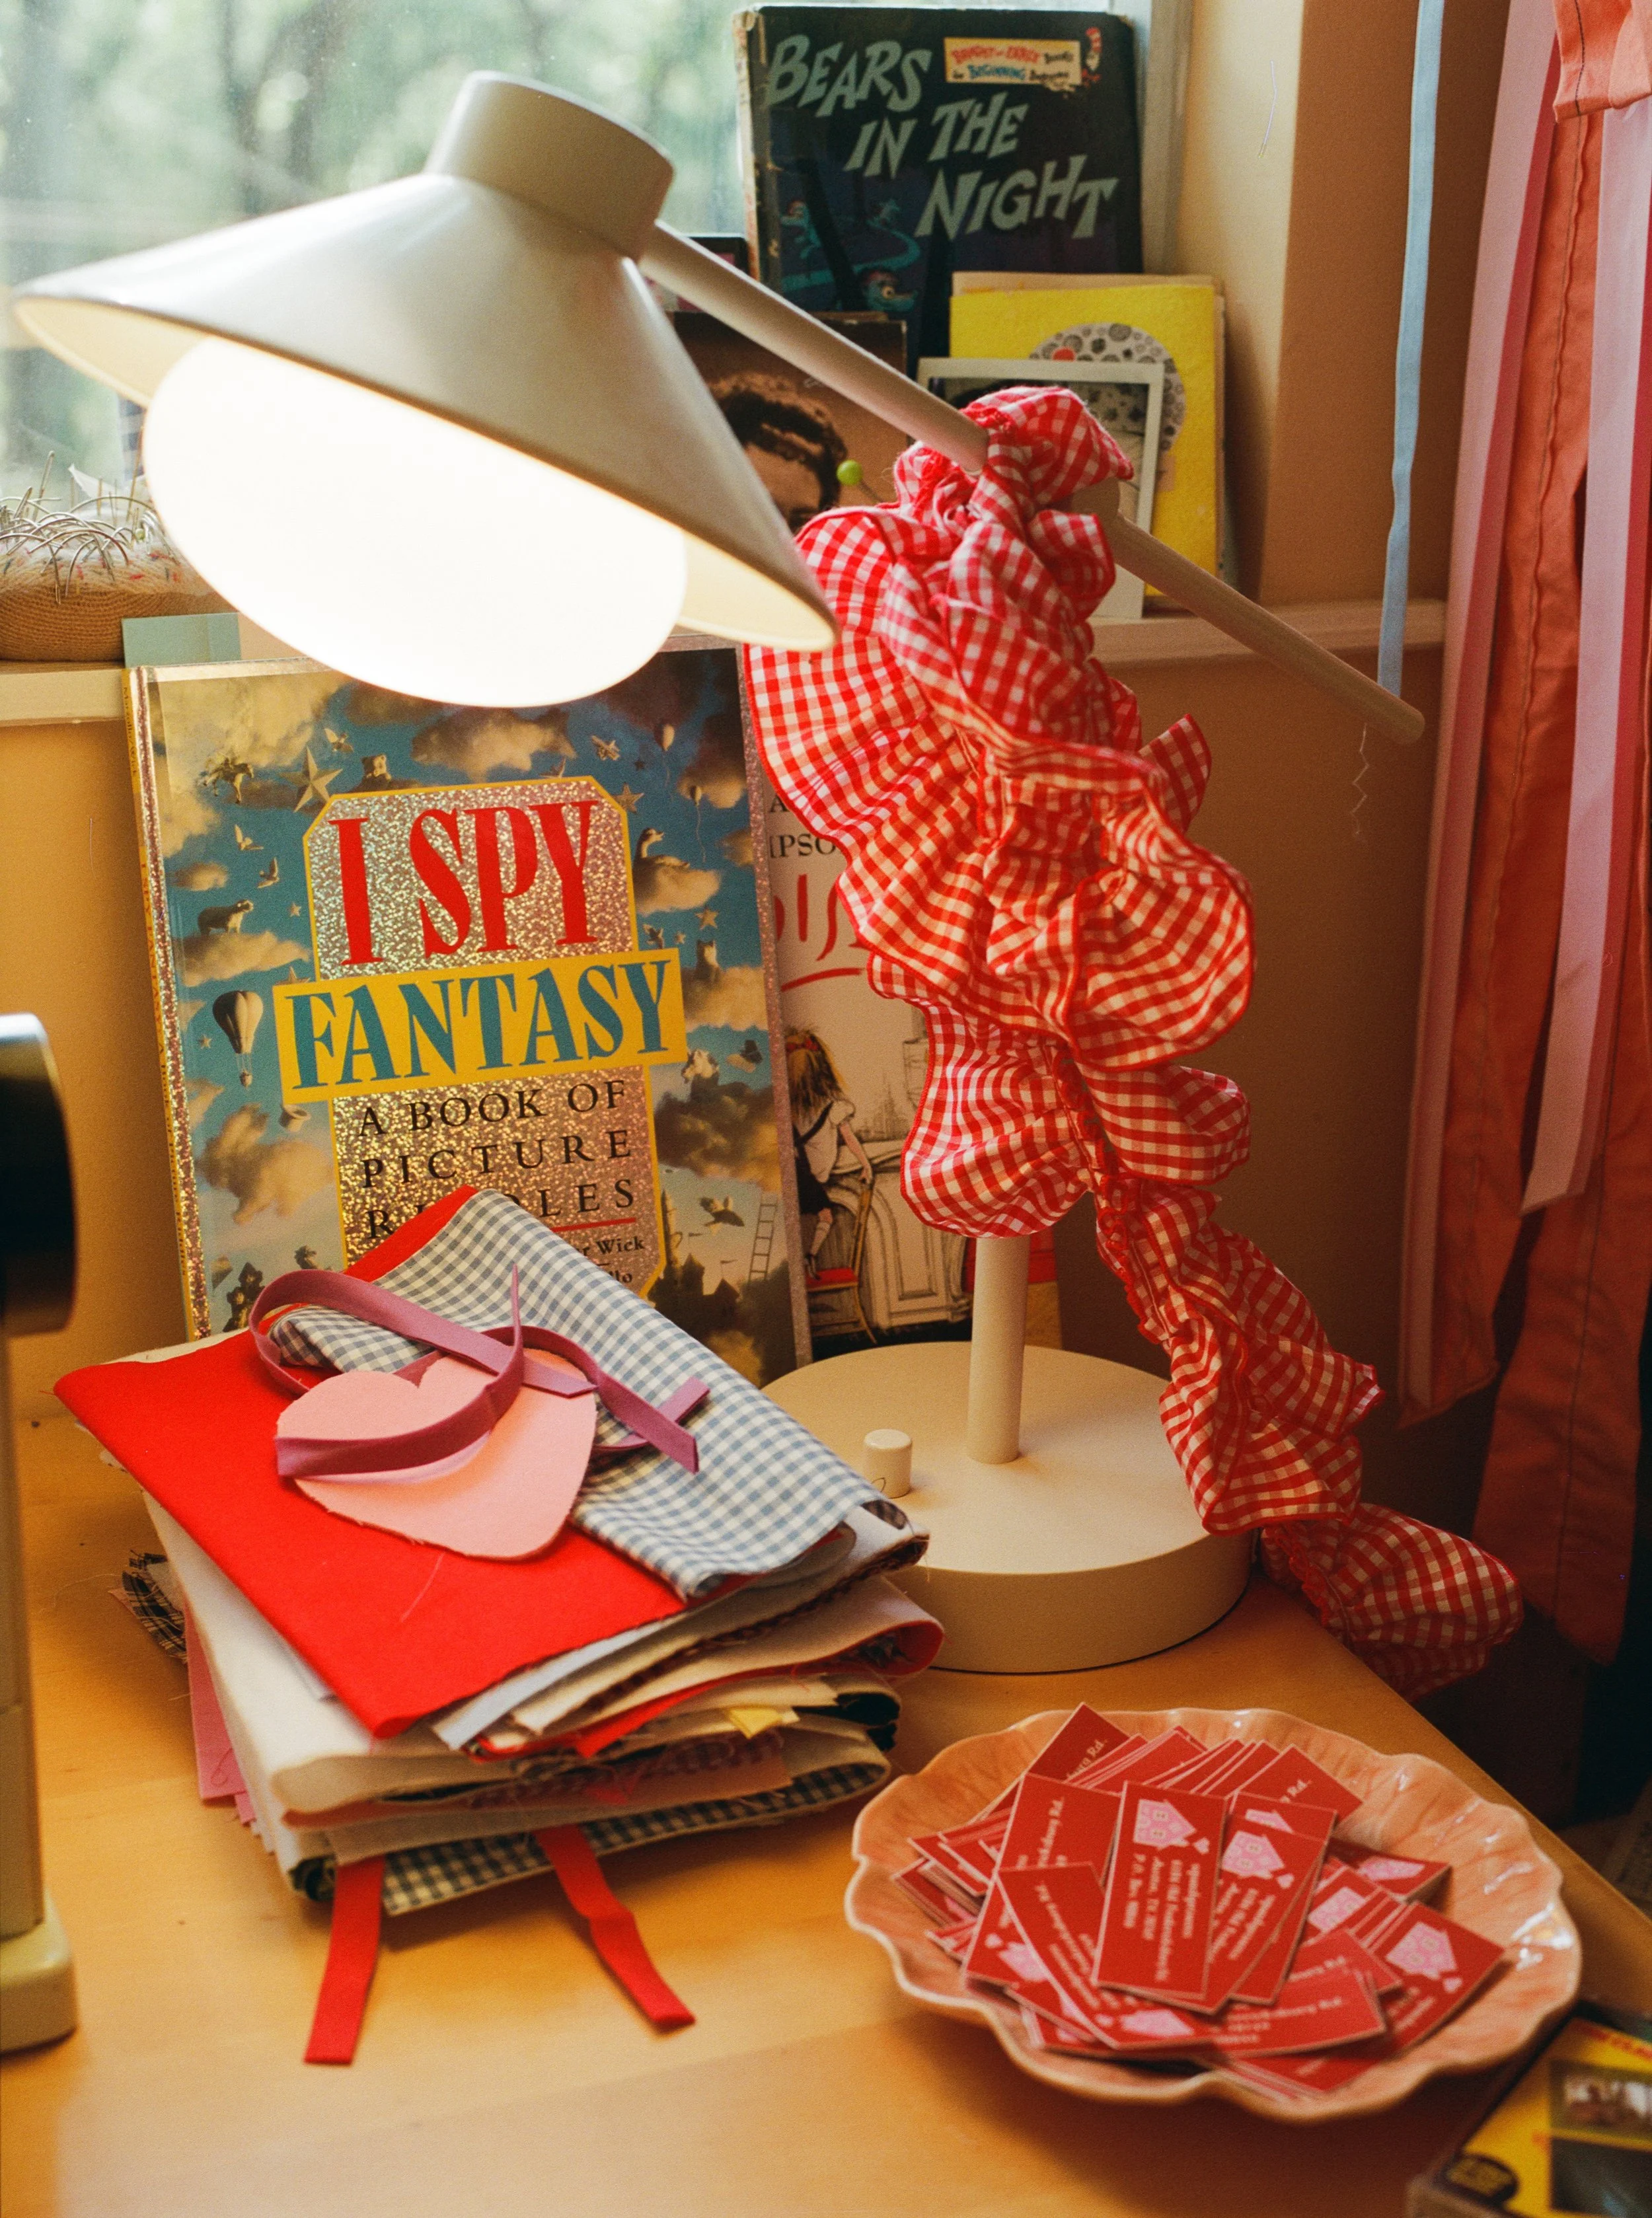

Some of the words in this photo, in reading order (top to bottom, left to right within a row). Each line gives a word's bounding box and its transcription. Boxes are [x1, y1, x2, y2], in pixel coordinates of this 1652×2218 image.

[767, 35, 932, 118] BEARS
[844, 118, 919, 179] IN
[926, 91, 1030, 163] THE
[913, 153, 1119, 242] NIGHT
[328, 817, 383, 966] I
[410, 800, 598, 960] SPY
[285, 959, 670, 1090] FANTASY
[358, 1107, 386, 1136] A
[407, 1089, 546, 1131] BOOK
[568, 1080, 626, 1113] OF
[362, 1129, 632, 1188] PICTURE
[367, 1179, 634, 1239] RLES
[596, 1236, 645, 1255] Wick
